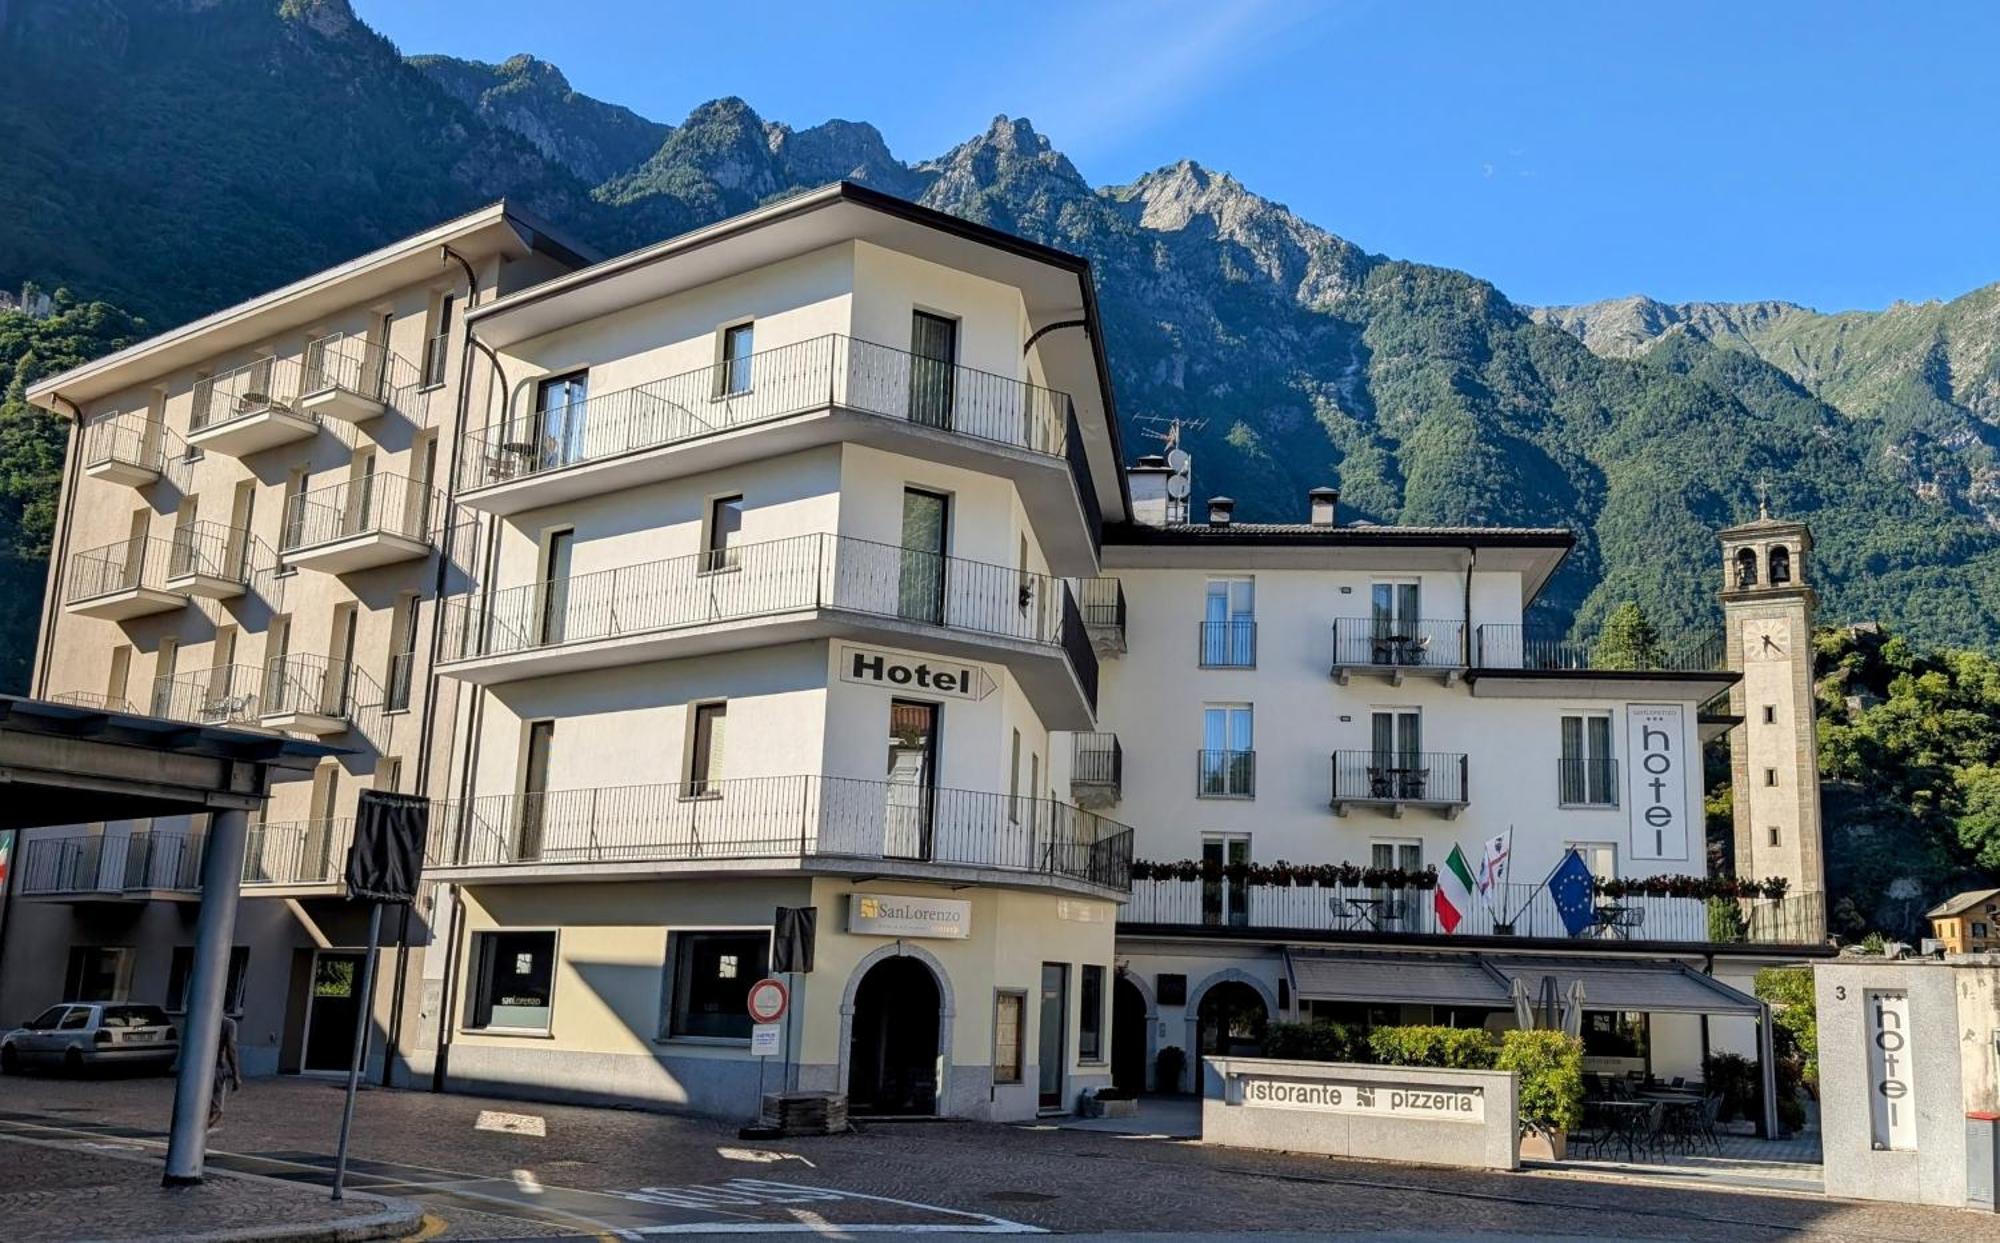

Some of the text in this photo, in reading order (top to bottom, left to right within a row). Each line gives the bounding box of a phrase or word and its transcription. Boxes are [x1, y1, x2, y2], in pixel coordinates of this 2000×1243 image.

[853, 653, 970, 694] Hotel
[1642, 725, 1672, 856] hotel
[880, 904, 960, 921] SanLorenzo
[1836, 986, 1846, 1000] 3
[1876, 1005, 1907, 1127] hotel
[1242, 1081, 1473, 1112] ristorante pizzeria
